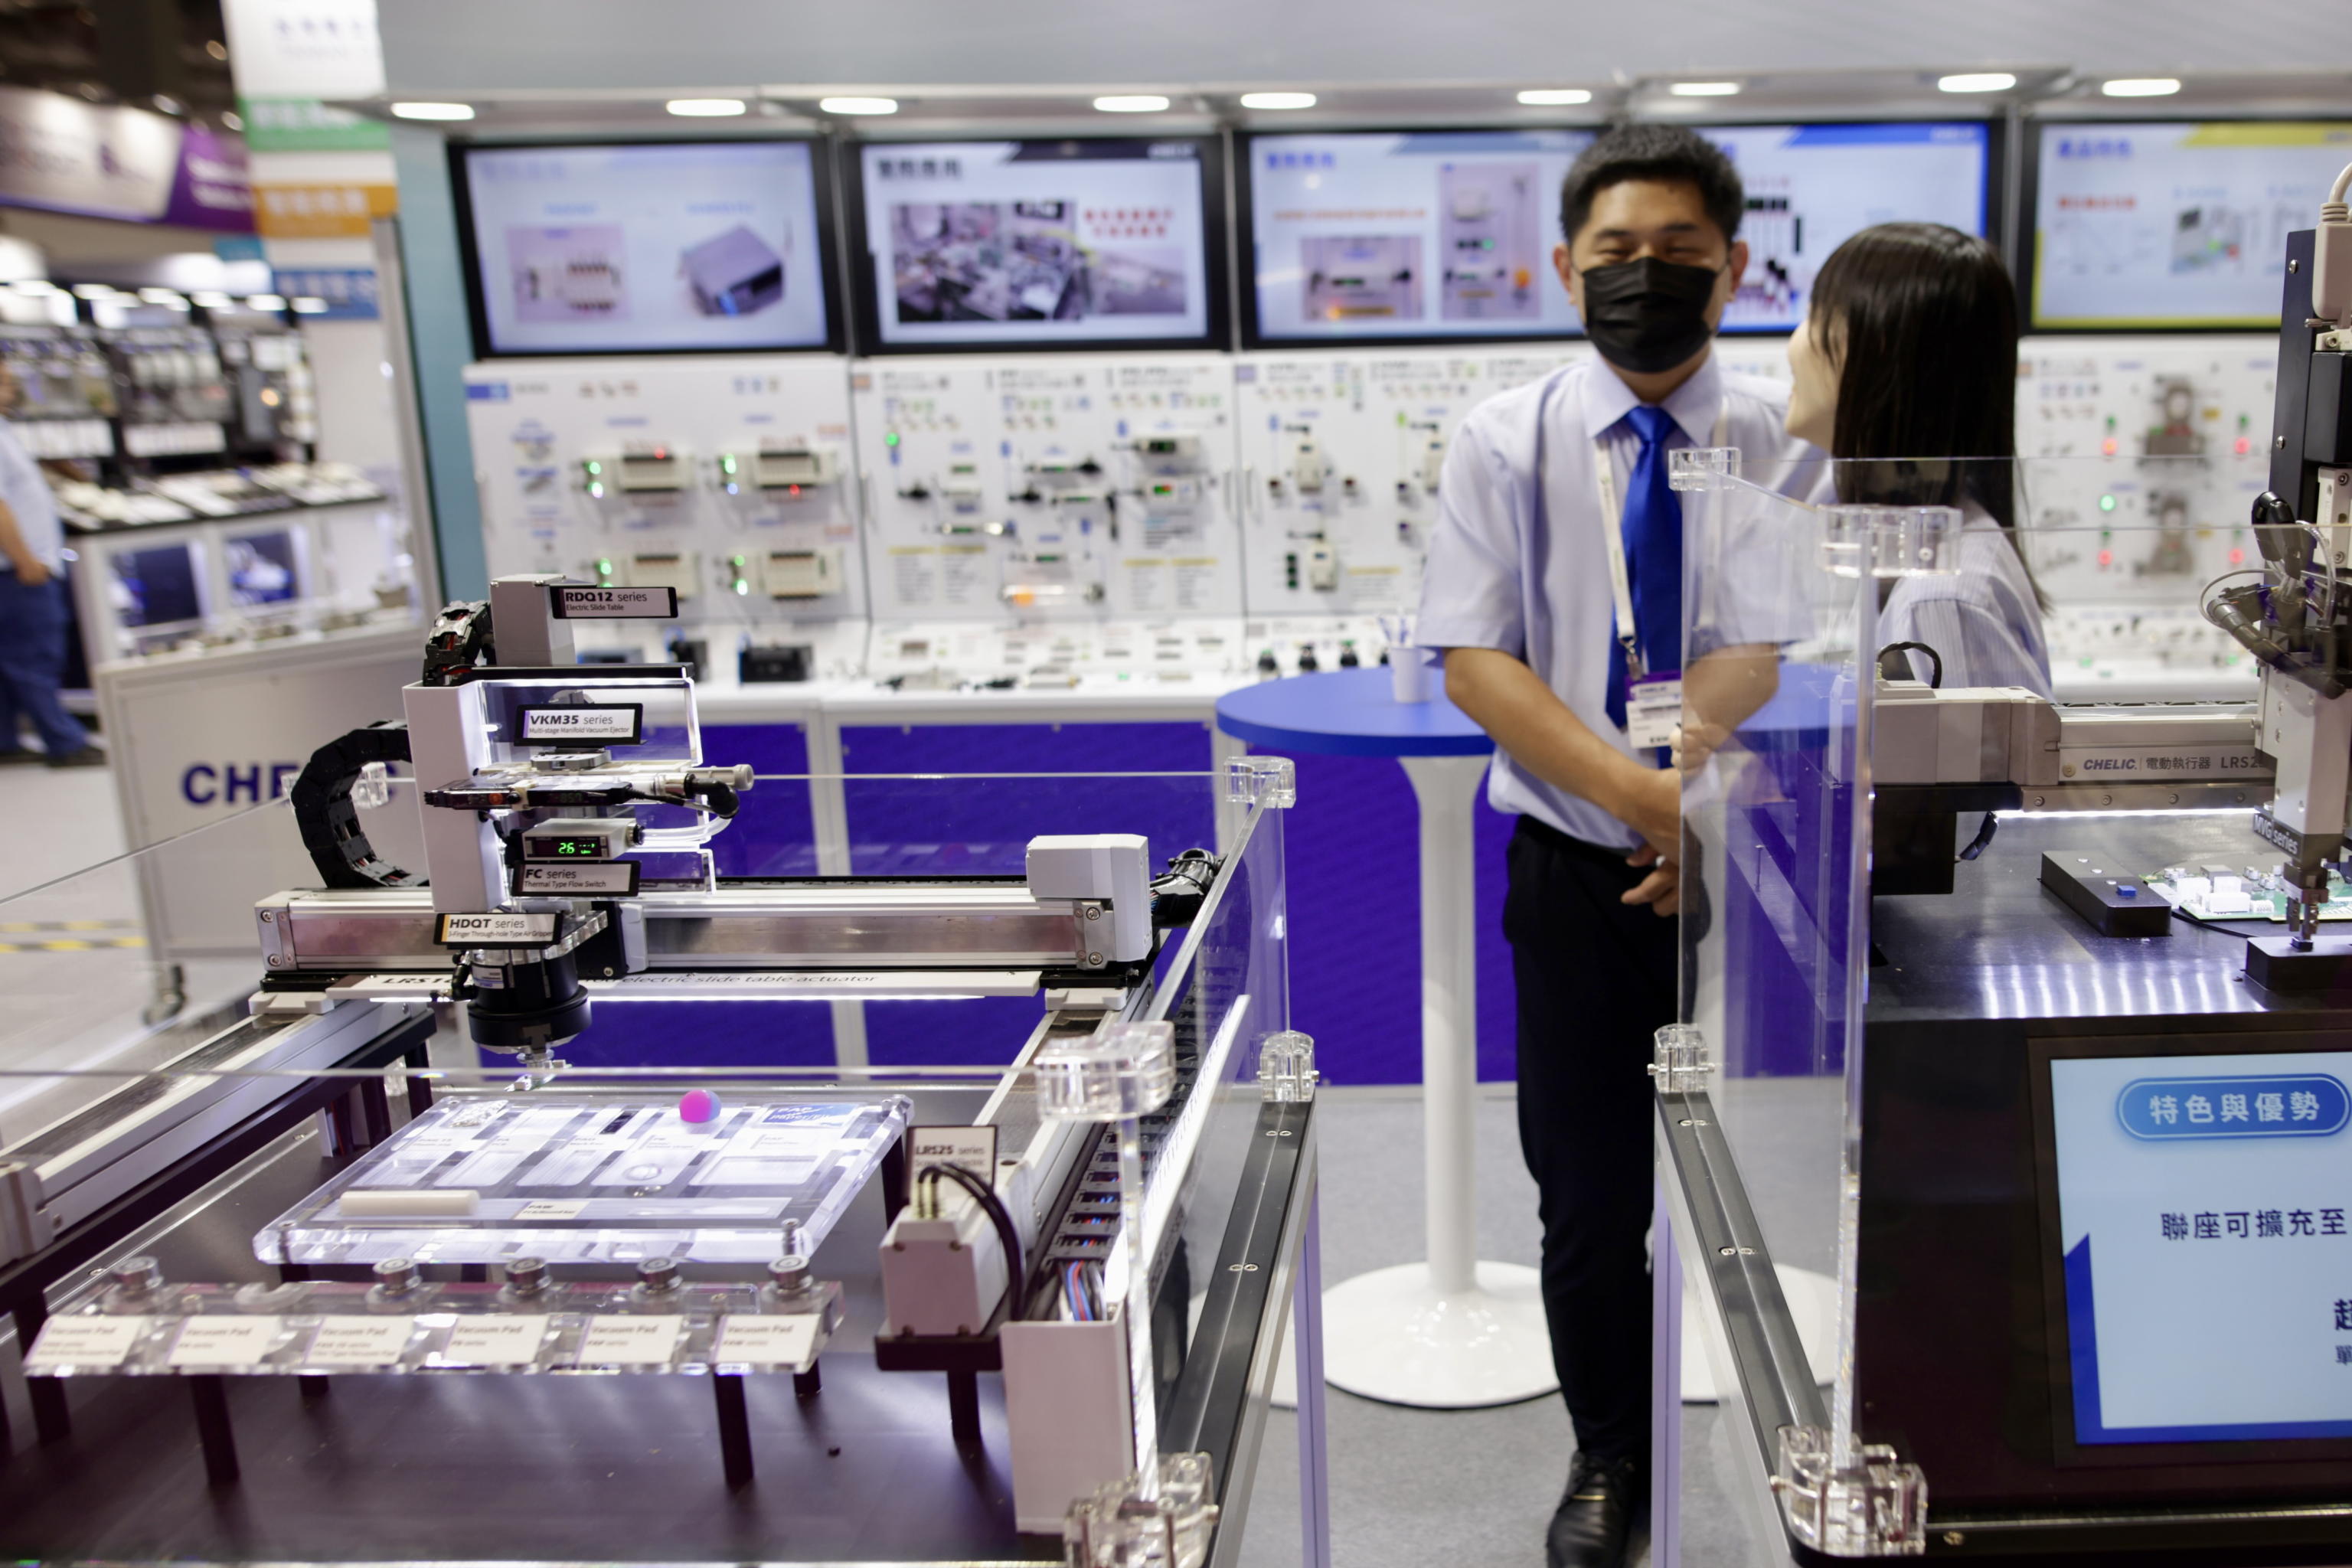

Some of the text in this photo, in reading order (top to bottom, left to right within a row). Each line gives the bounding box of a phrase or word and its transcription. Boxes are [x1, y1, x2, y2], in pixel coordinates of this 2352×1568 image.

[565, 592, 648, 602] RDQ12 series
[531, 715, 613, 725] VKM35 series
[2146, 756, 2211, 770] 電動執行器
[2254, 814, 2298, 854] MVG series
[525, 869, 577, 878] FC series
[449, 919, 525, 929] HDQT series
[2149, 1090, 2320, 1125] 特色與優勢
[915, 1145, 954, 1155] LRS25
[2161, 1208, 2347, 1240] 聯座可擴充至
[230, 1327, 253, 1335] Pad
[366, 1327, 389, 1335] Pad
[501, 1325, 524, 1334] Pad
[637, 1325, 659, 1334] Pad
[772, 1325, 794, 1333] Pad
